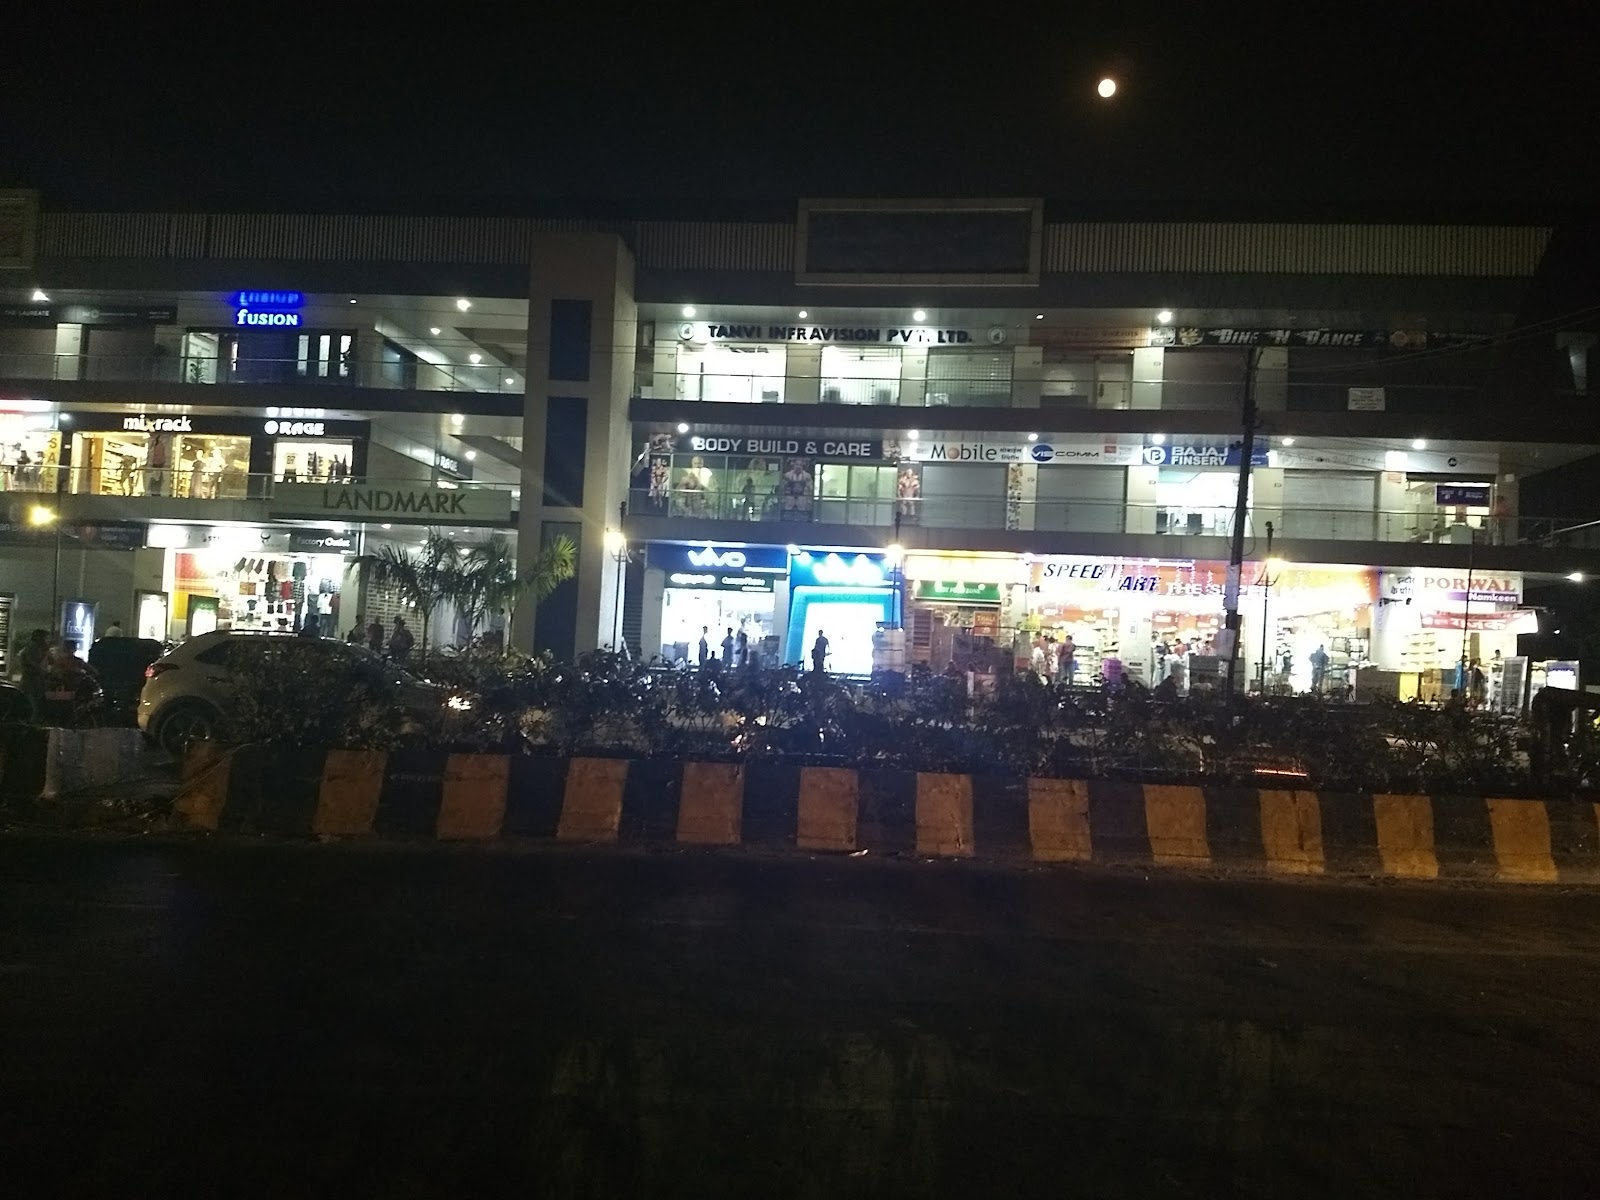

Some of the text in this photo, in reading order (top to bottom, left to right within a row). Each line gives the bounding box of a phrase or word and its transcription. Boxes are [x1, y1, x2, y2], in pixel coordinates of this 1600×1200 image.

[708, 325, 761, 339] TANVI
[769, 326, 880, 341] INFRAVISION
[123, 414, 192, 432] mixrack
[693, 438, 871, 456] BODY BUILD & CARE
[931, 443, 997, 461] Mobile
[1171, 446, 1229, 456] BAJAJ
[1171, 456, 1228, 466] FINSERV
[322, 488, 467, 515] LANDMARK
[1043, 563, 1103, 579] SPEED
[1423, 577, 1516, 592] PORWAL
[1468, 593, 1517, 602] Namkeen
